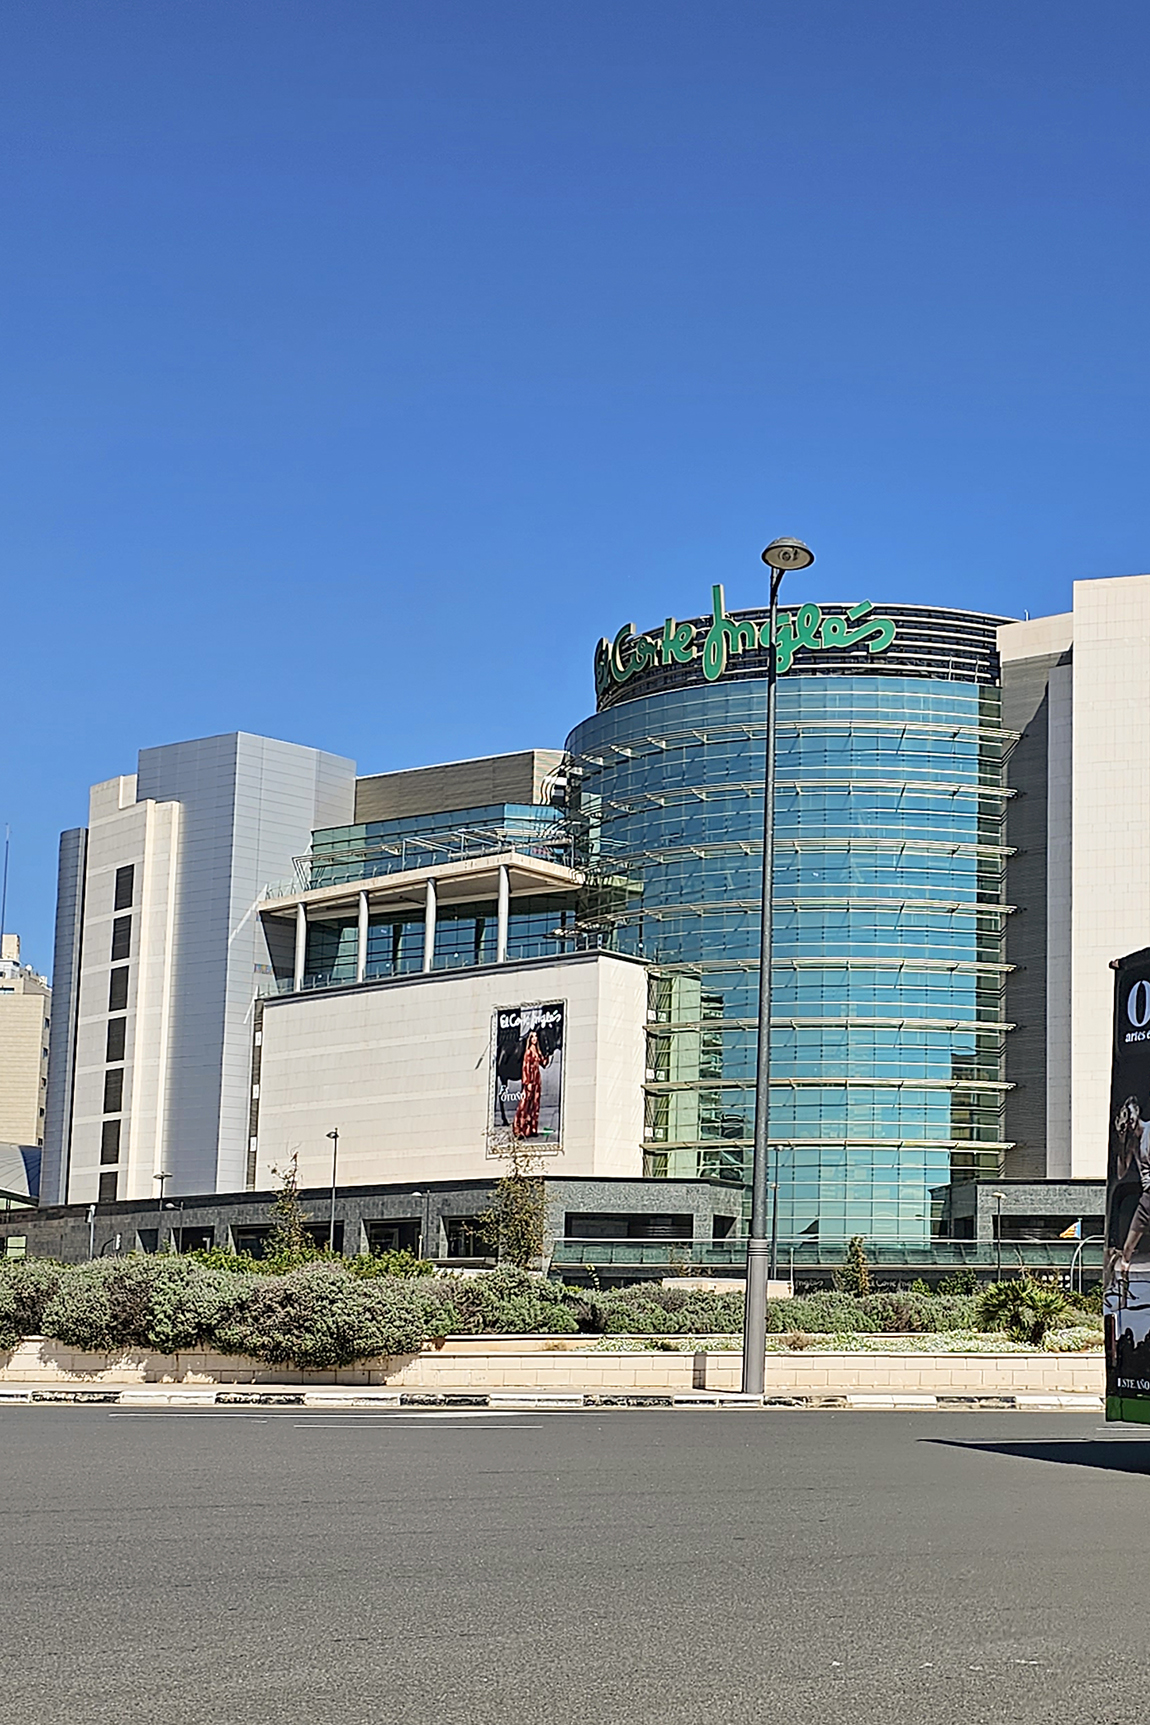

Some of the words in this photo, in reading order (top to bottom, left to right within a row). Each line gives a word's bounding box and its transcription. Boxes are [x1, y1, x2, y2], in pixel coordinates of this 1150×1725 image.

[611, 617, 698, 682] Corte
[703, 584, 896, 681] Inglés
[1125, 1031, 1146, 1043] artes
